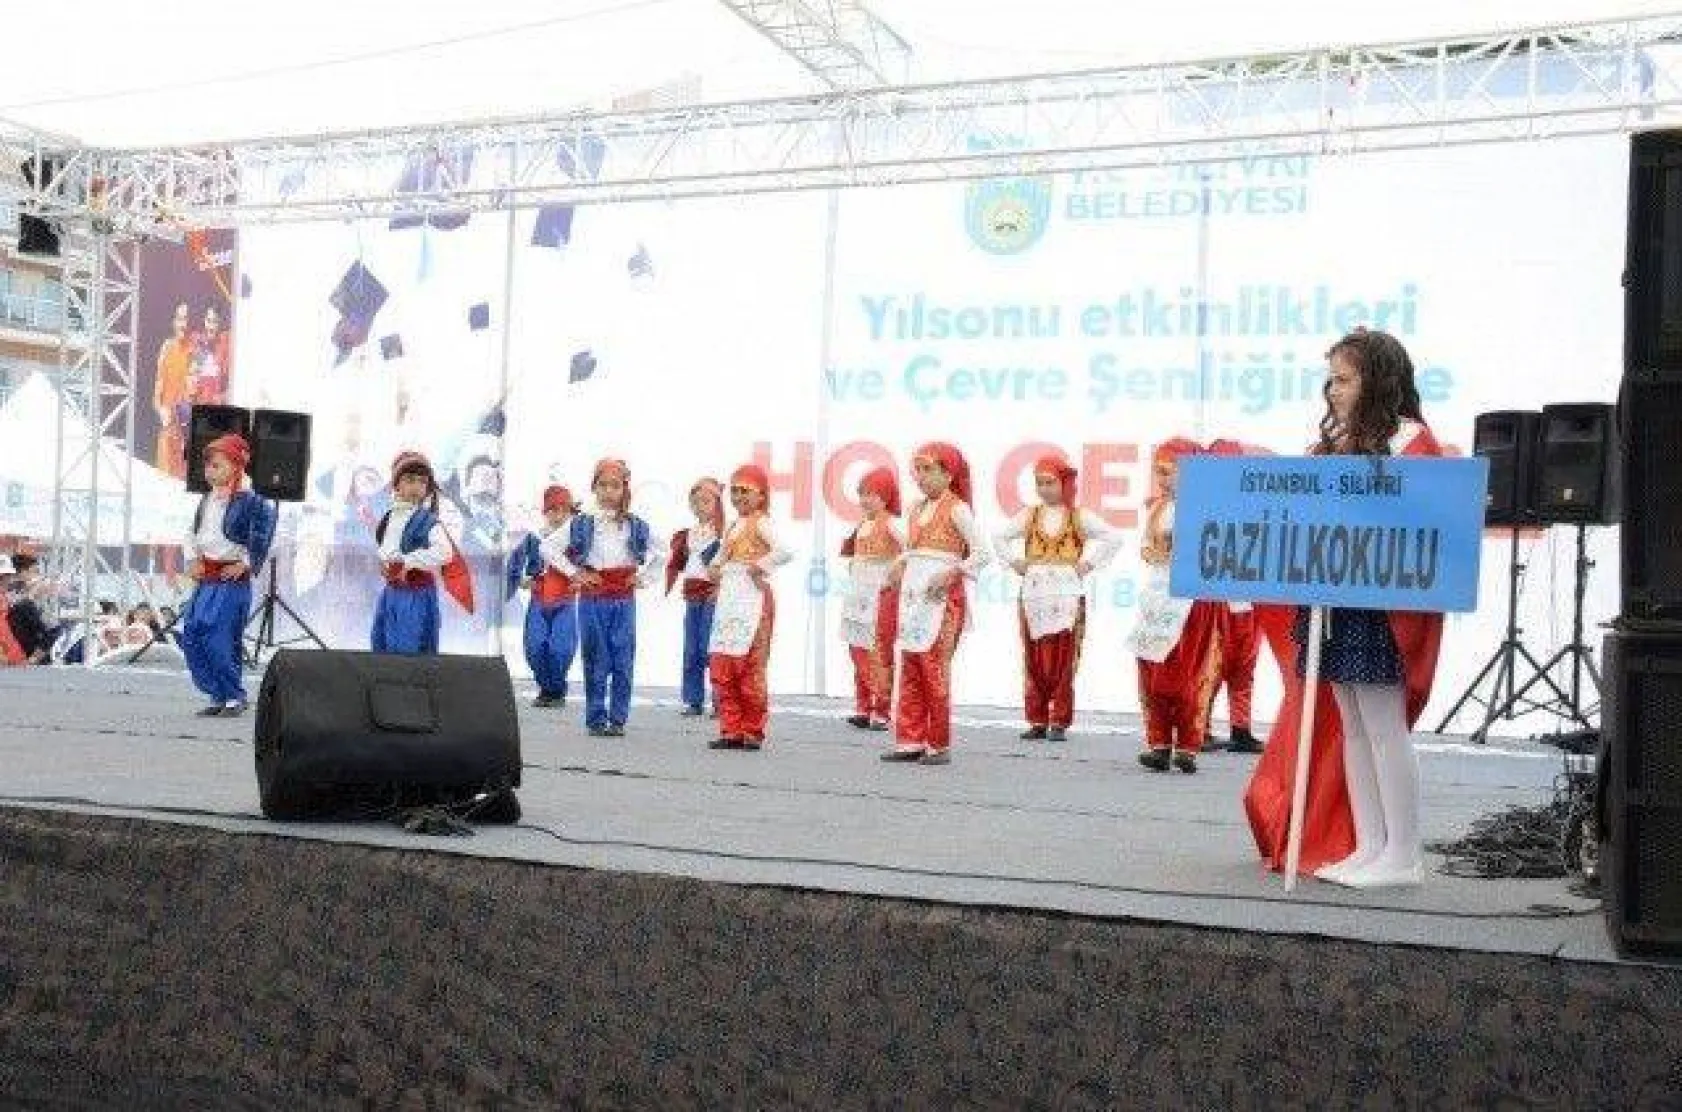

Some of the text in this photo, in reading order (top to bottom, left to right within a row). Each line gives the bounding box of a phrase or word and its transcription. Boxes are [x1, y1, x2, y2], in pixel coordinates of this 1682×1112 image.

[861, 293, 1062, 340] Yılsonu
[825, 366, 886, 402] ve
[902, 355, 1069, 411] Çevre
[1240, 470, 1323, 494] İSTANBUL
[1200, 509, 1271, 582] GAZİ
[1276, 509, 1442, 590] İLKOKULU
